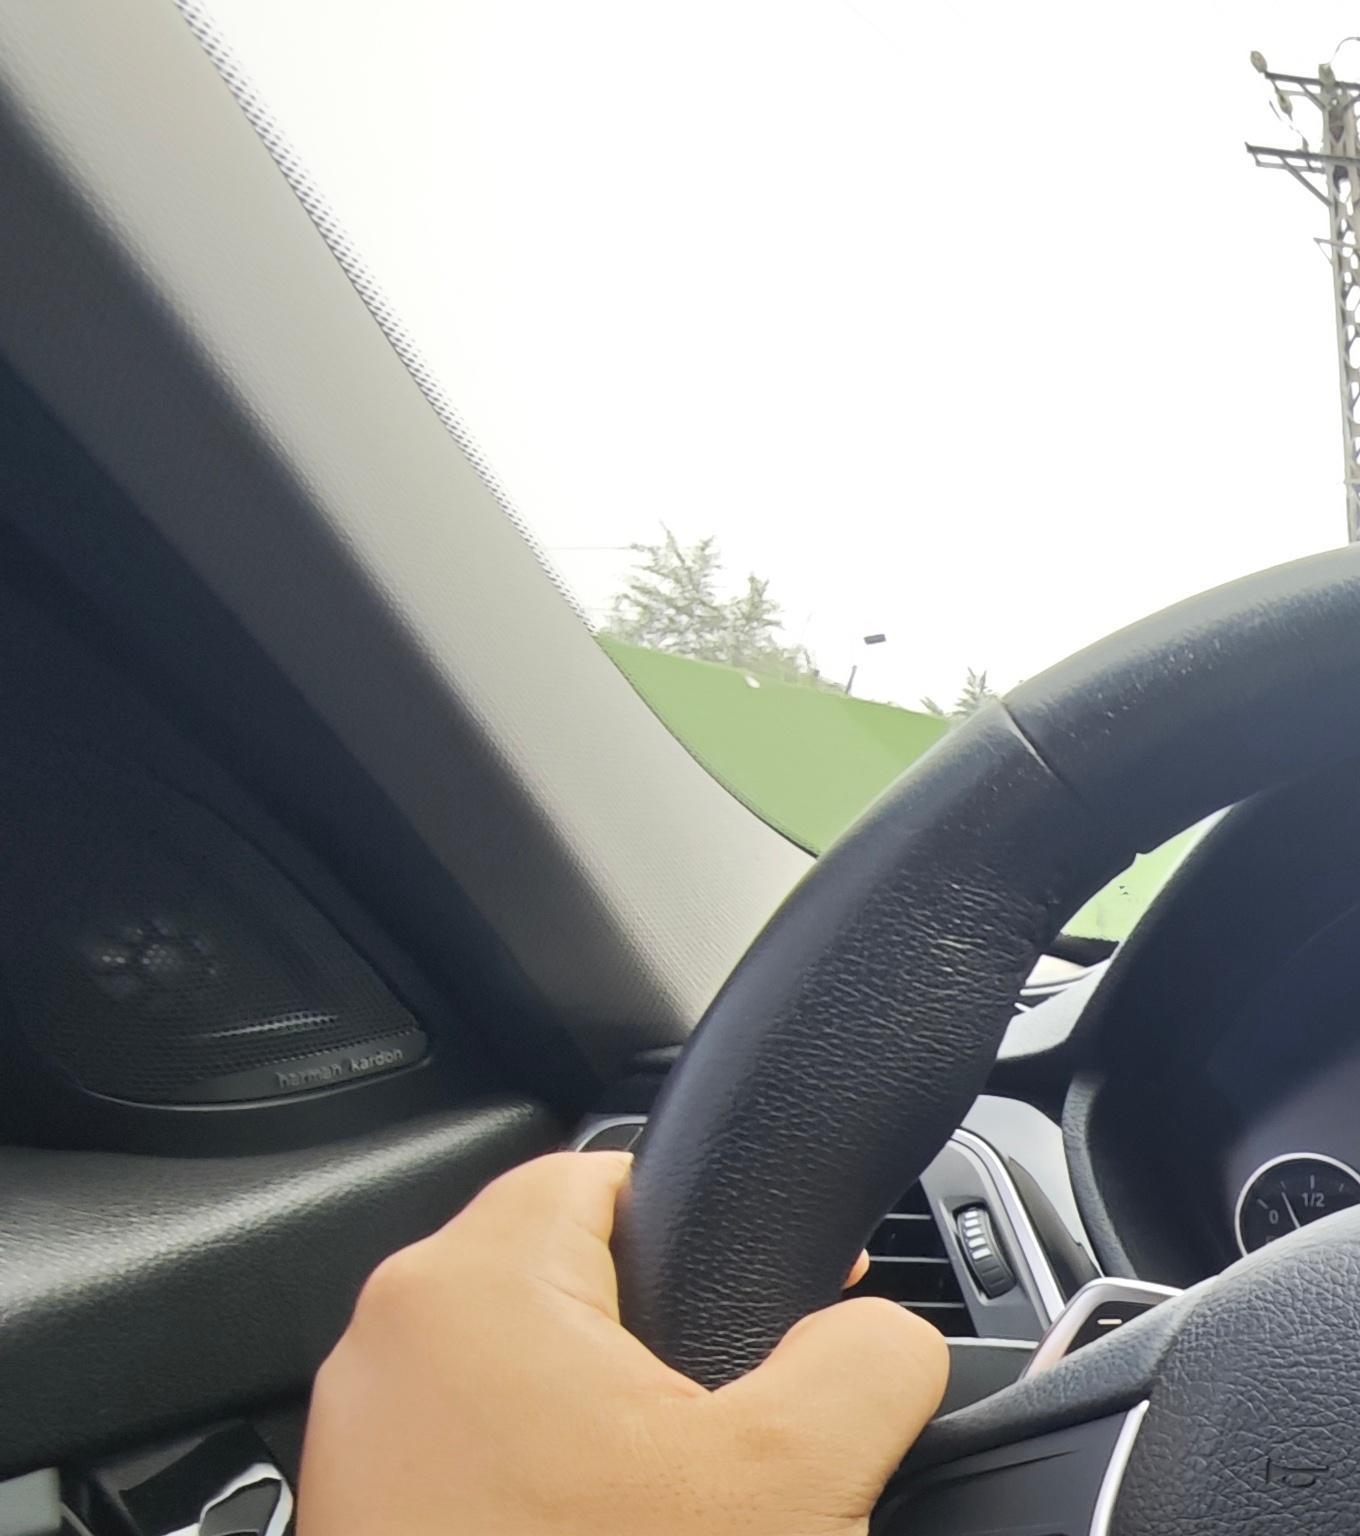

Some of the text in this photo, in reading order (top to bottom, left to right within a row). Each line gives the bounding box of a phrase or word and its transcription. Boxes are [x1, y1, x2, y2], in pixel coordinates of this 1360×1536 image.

[278, 1049, 403, 1088] harman kardon
[1301, 1192, 1325, 1208] 1/2
[1268, 1209, 1279, 1225] 0
